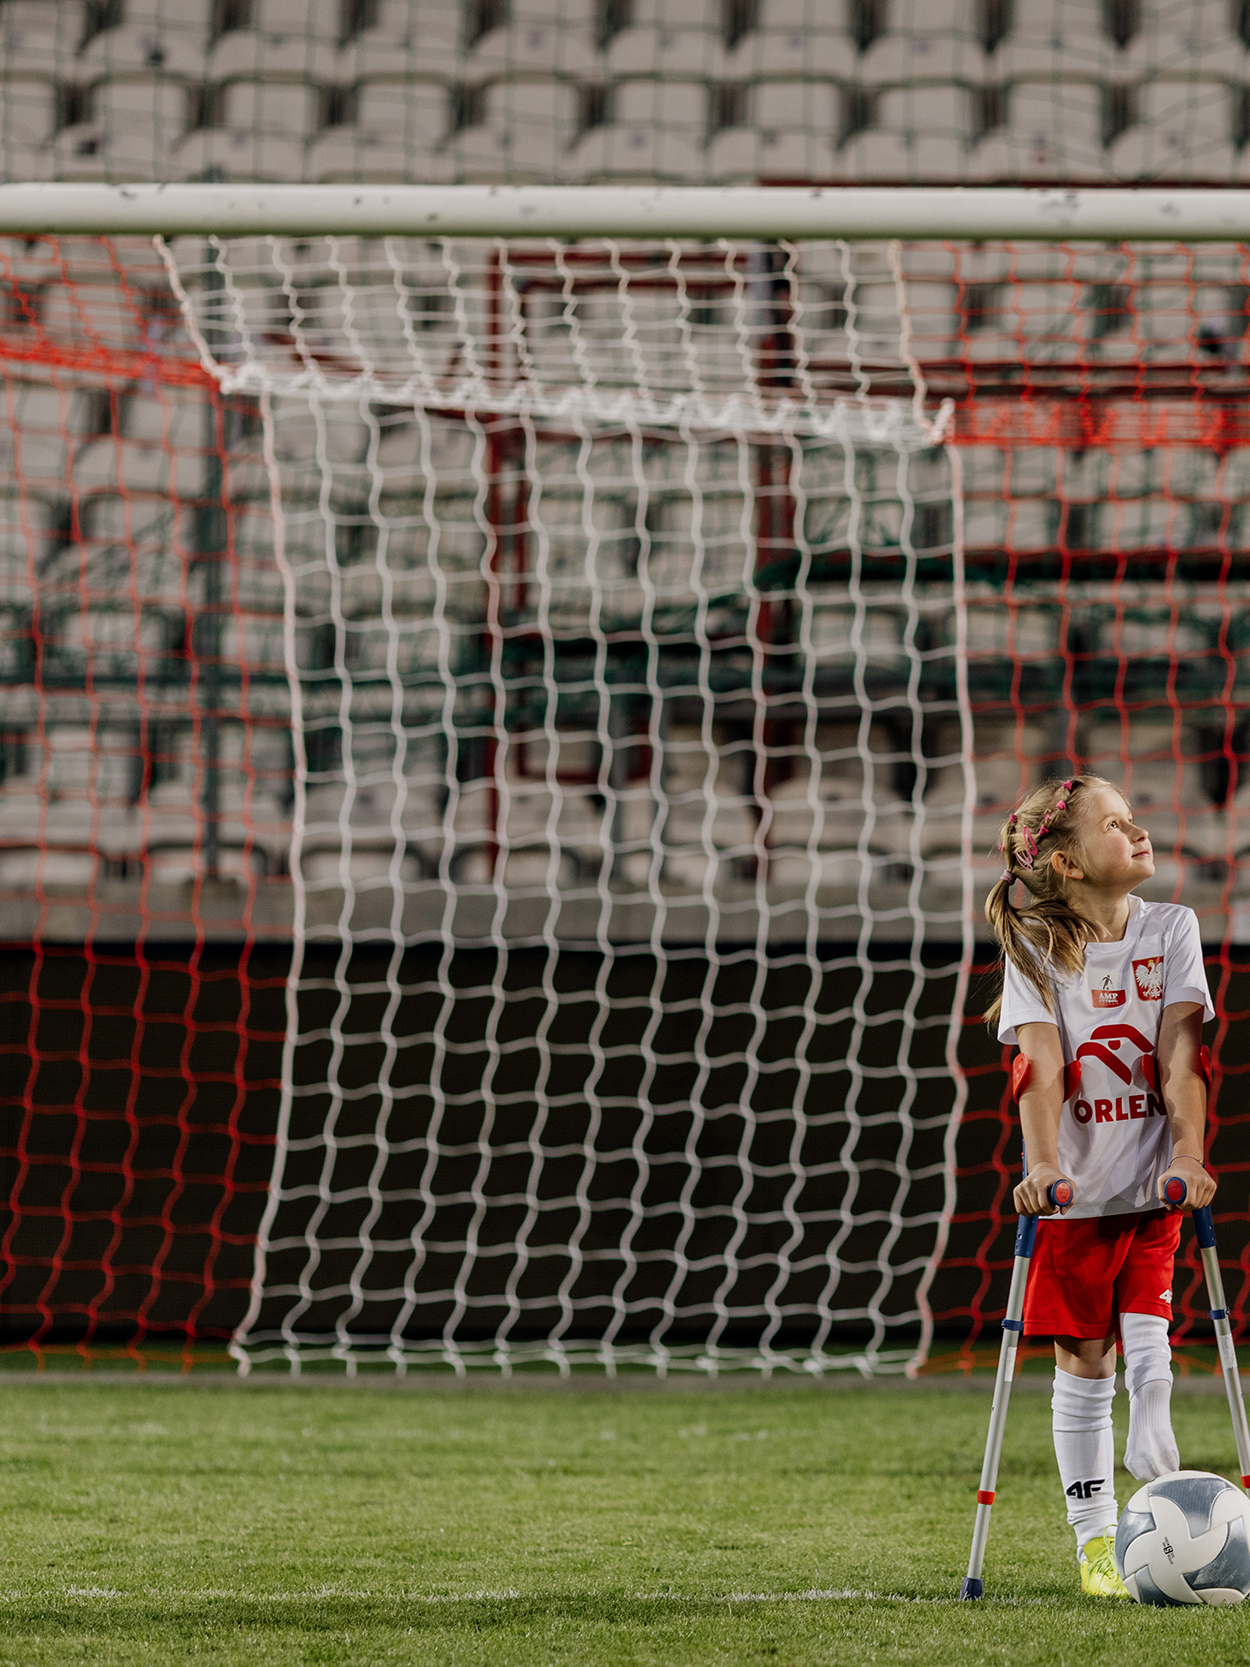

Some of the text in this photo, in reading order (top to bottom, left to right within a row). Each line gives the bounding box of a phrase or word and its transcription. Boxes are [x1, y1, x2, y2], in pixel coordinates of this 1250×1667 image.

[1099, 992, 1119, 1000] AMP
[1074, 1093, 1168, 1124] ORLEN
[1066, 1478, 1105, 1499] 4F
